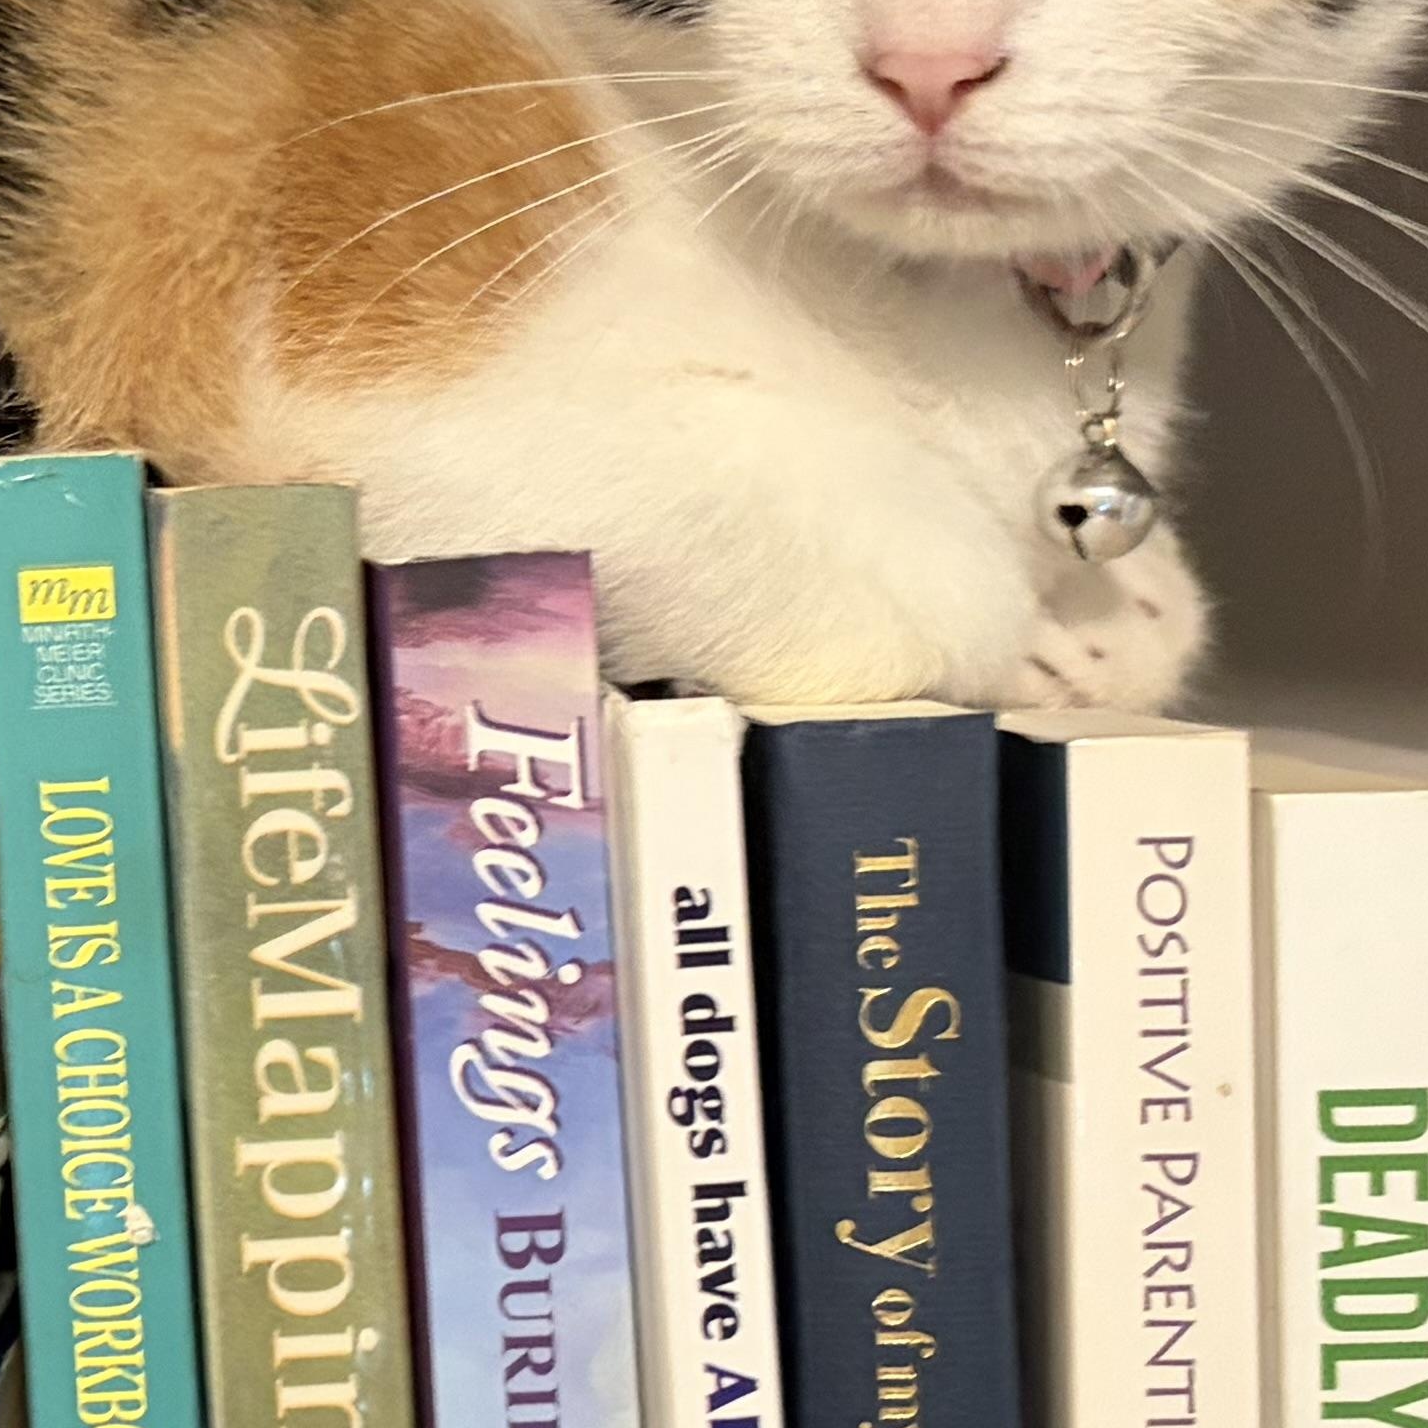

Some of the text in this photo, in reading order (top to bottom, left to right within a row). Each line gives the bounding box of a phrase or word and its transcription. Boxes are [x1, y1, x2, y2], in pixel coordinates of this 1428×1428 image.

[34, 683, 112, 703] SERIES
[37, 663, 105, 684] CLINIC
[39, 776, 118, 911] LOVE
[854, 837, 920, 971] The
[47, 921, 122, 970] IS
[451, 700, 586, 1181] Feelings
[673, 886, 732, 970] all
[1135, 836, 1195, 1124] POSITIVE
[52, 980, 124, 1021] A
[54, 1028, 135, 1221] CHOICE
[668, 992, 737, 1159] dogs
[836, 986, 961, 1278] Story
[691, 1179, 747, 1341] have
[871, 1288, 936, 1359] of
